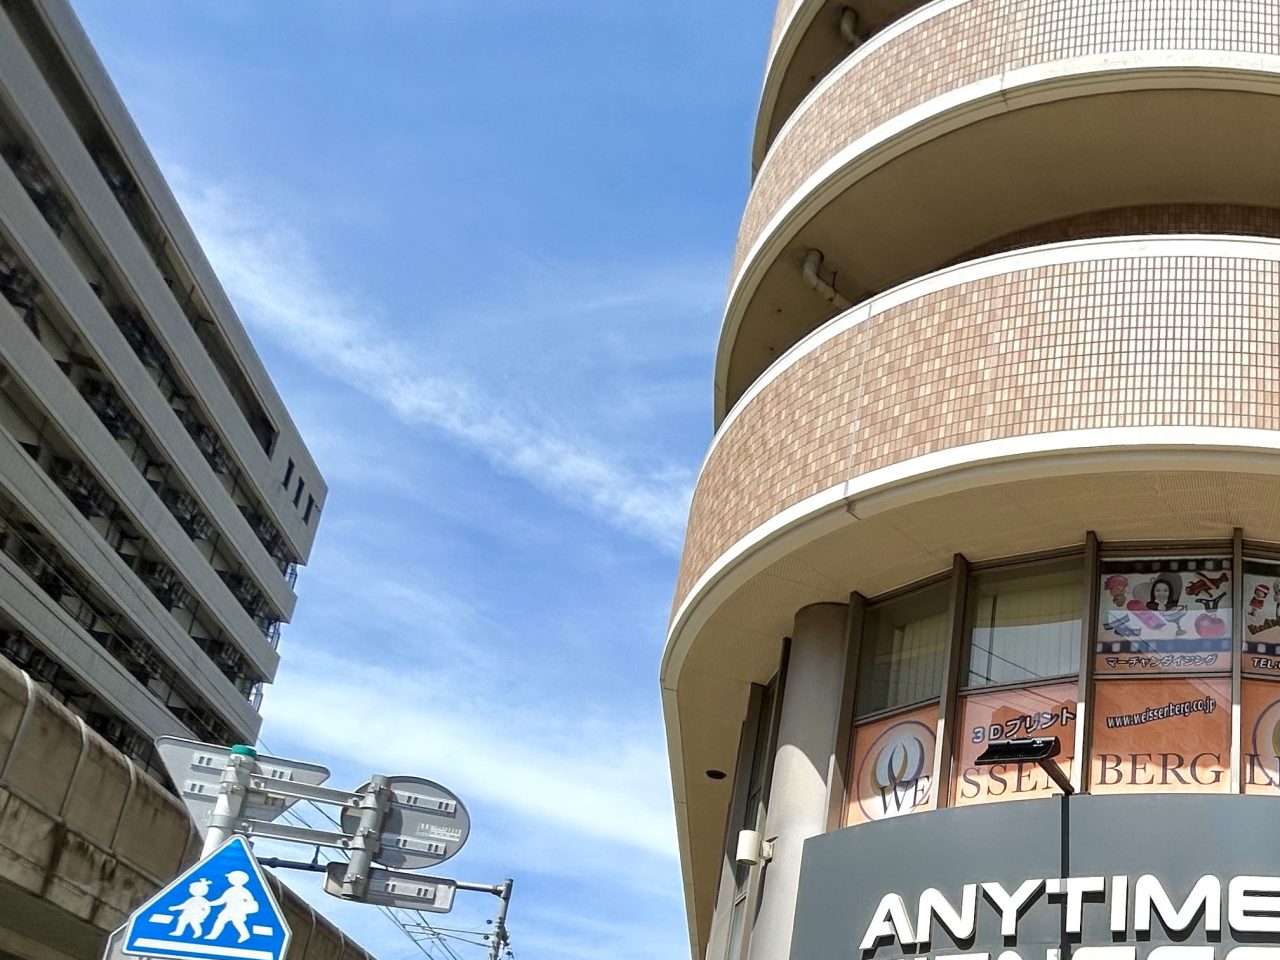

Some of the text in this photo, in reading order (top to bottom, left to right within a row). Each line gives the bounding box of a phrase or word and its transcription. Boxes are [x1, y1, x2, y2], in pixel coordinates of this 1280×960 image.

[1106, 654, 1218, 668] マーチャンダイジング
[1095, 752, 1225, 786] BERG
